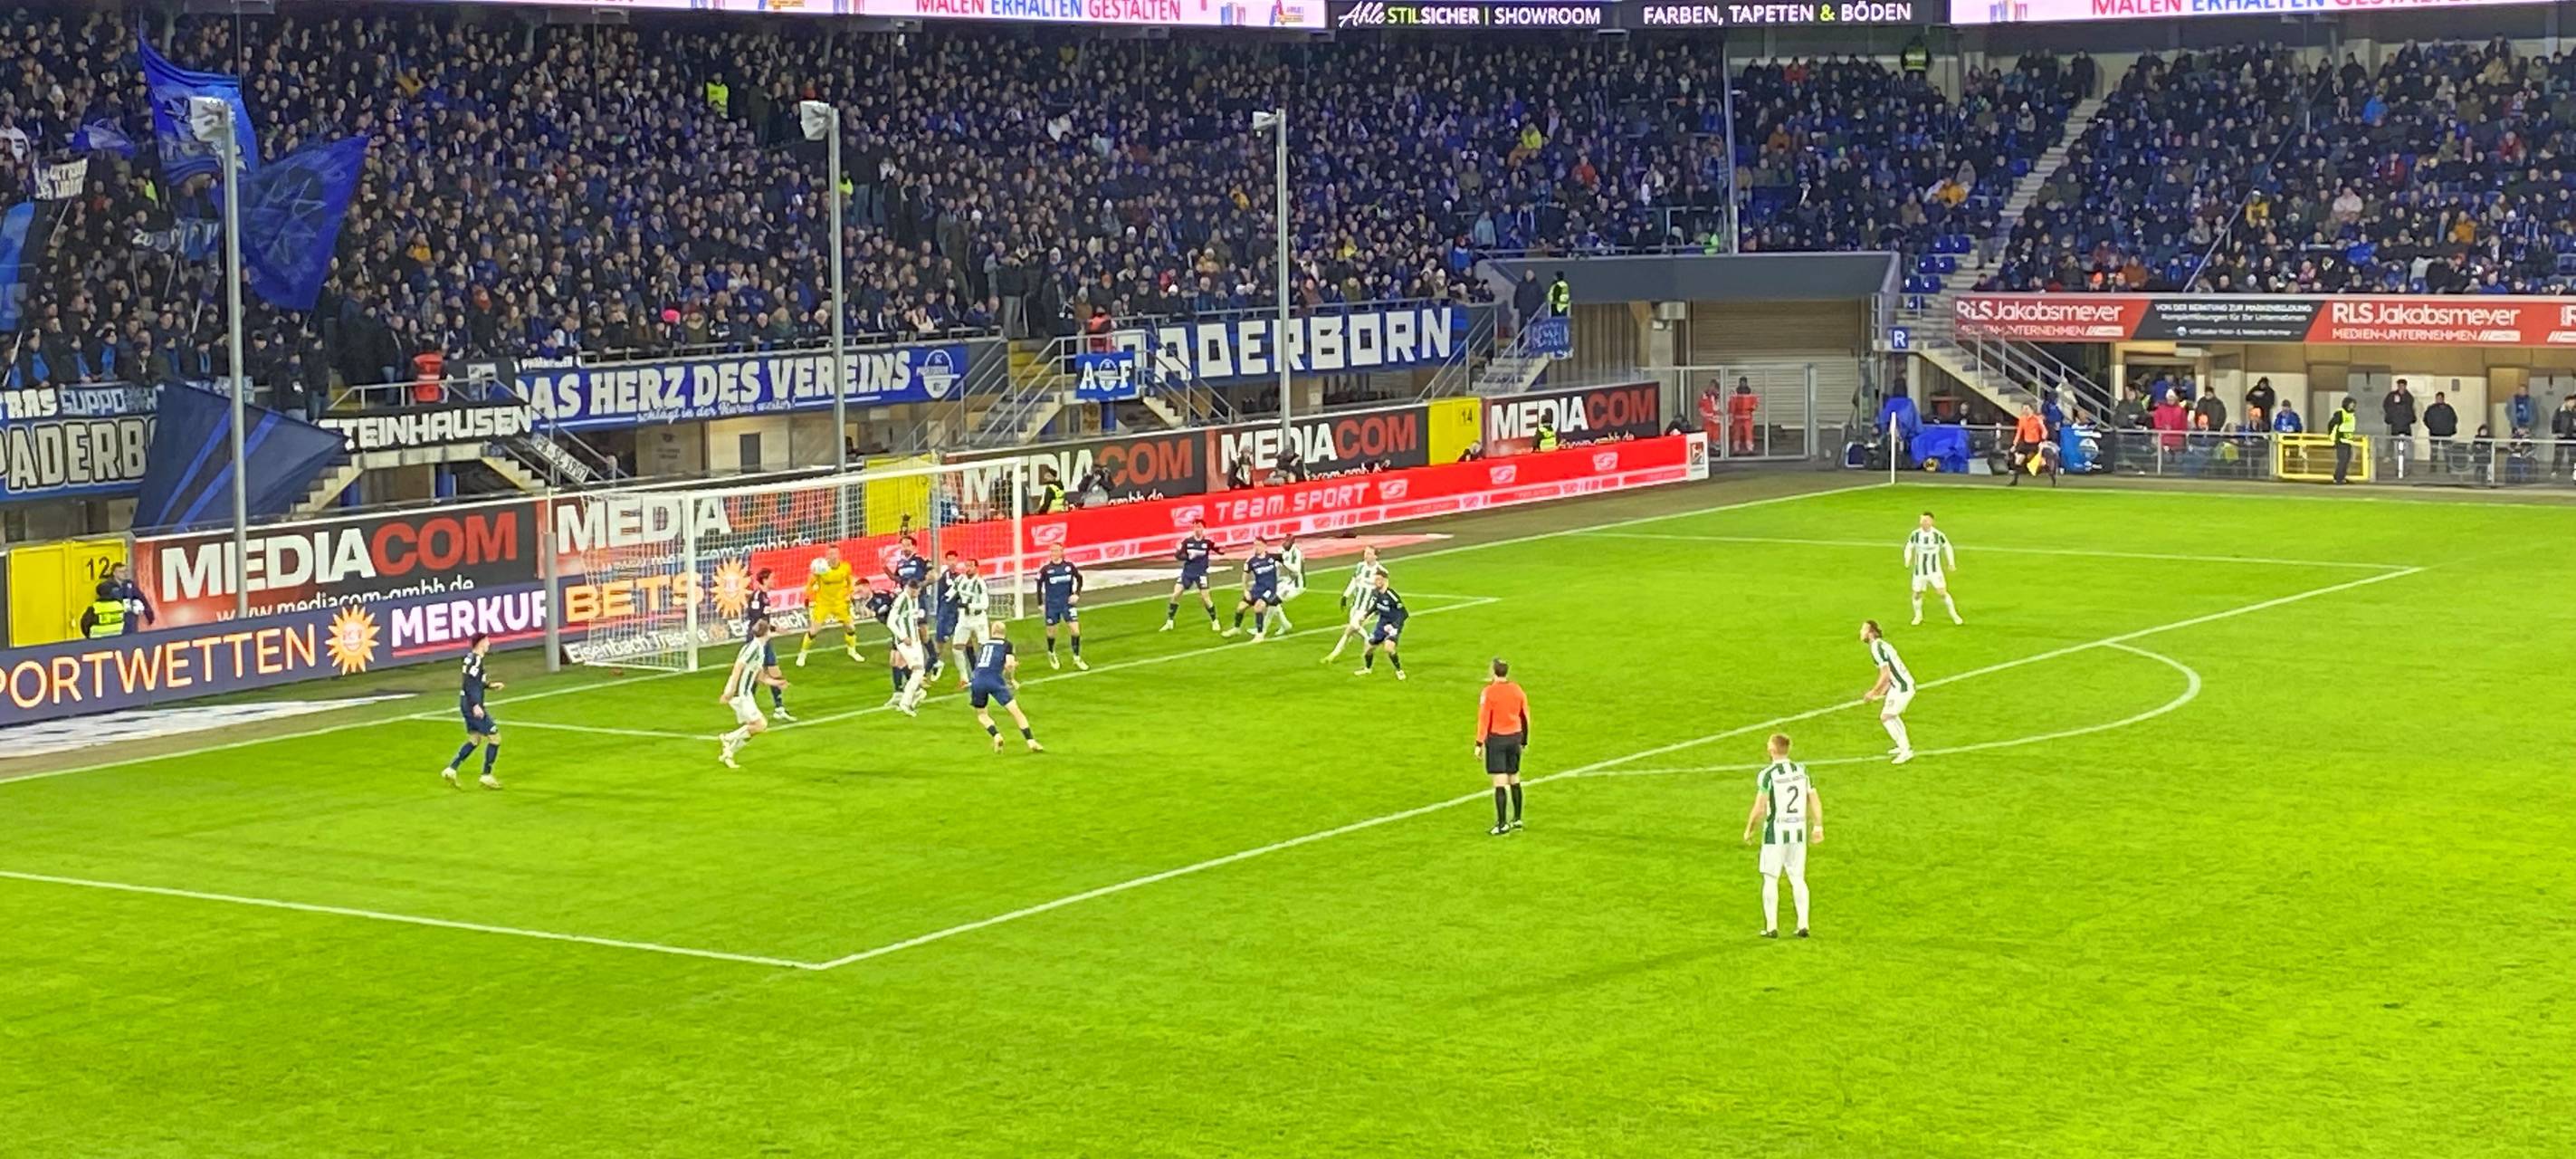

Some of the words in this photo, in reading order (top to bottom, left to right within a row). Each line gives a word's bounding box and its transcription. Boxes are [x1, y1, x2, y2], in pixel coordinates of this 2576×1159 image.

[990, 0, 1083, 17] ERHALTEN
[1089, 0, 1180, 21] GESTALTEN
[1387, 7, 1480, 25] STILSICHER
[1493, 7, 1600, 25] SHOWROOM
[1643, 5, 1723, 25] FARBEN,
[1728, 5, 1814, 24] TAPETEN
[1819, 5, 1836, 22] &
[1840, 2, 1912, 22] BÖDEN
[1994, 300, 2123, 322] Jakobsmeyer
[2332, 302, 2373, 324] RLS
[2374, 303, 2521, 326] Jakobsmeyer
[1894, 330, 1906, 348] R
[2332, 329, 2478, 341] MEDIEN-UNTERNEHMEN
[590, 366, 685, 416] HERZ
[693, 361, 761, 408] DES
[768, 350, 911, 399] VEREINS
[0, 388, 57, 420] RAS
[1461, 409, 1473, 423] 14
[1491, 388, 1656, 442] MEDIACOM
[0, 416, 157, 492] ADERB
[161, 510, 518, 603] MEDIACOM
[565, 571, 704, 623] BETS
[648, 628, 710, 650] Trese
[0, 623, 316, 708] ORTWETTEN
[1786, 785, 1799, 814] 2
